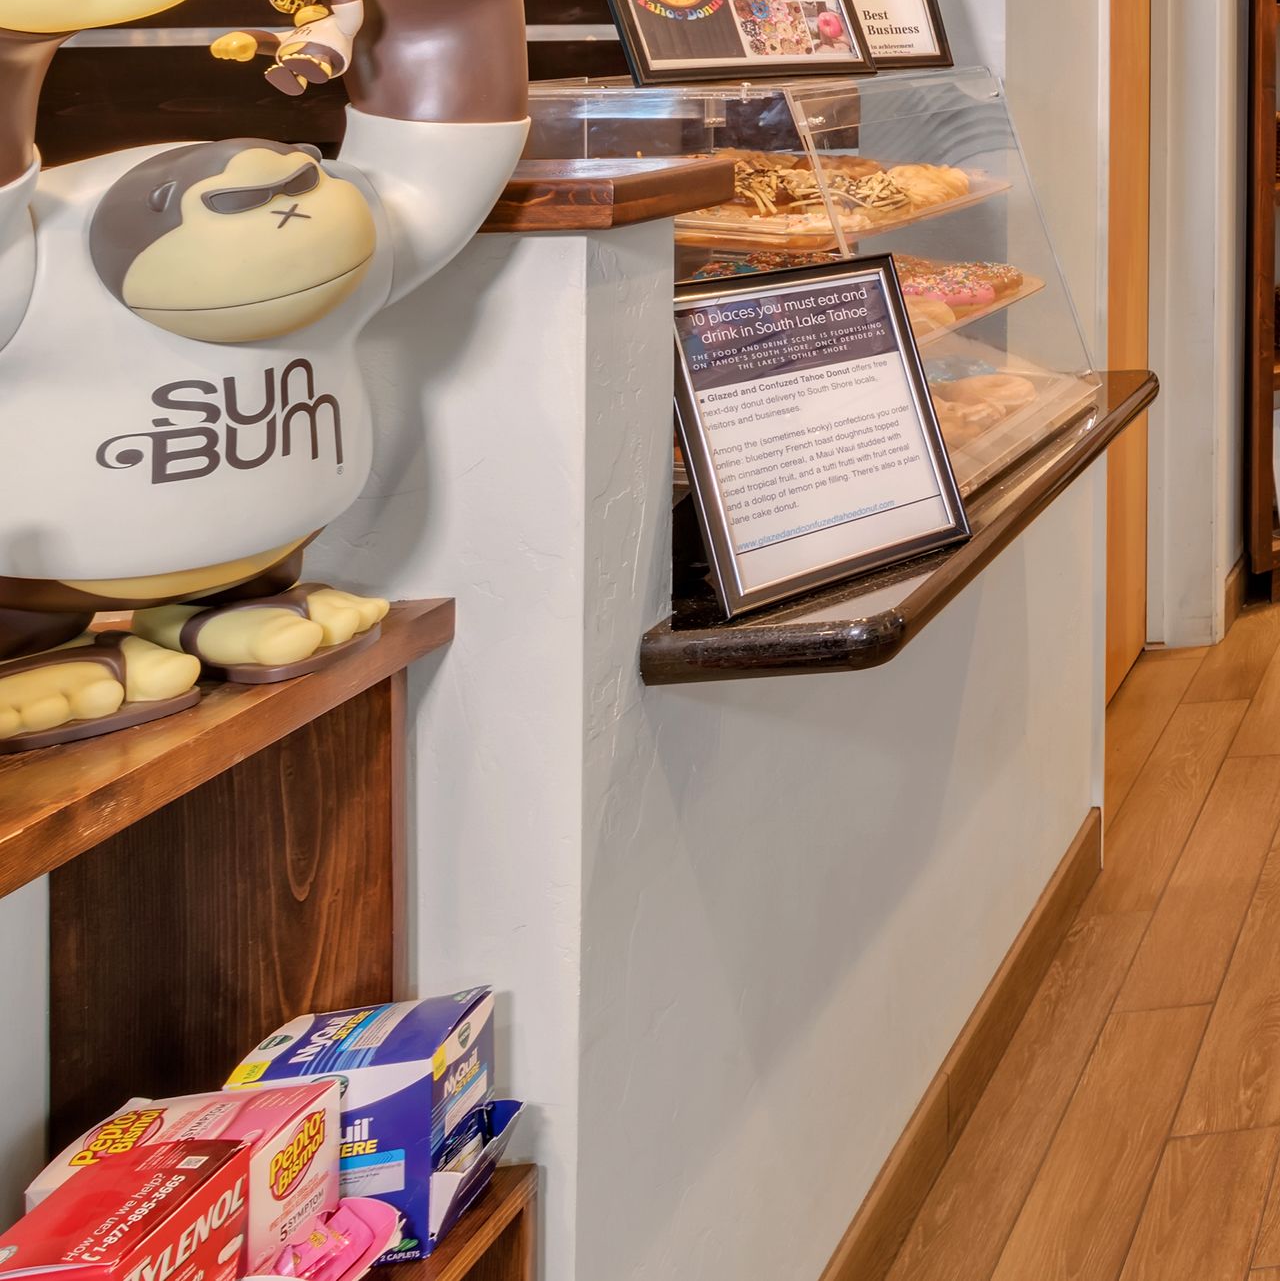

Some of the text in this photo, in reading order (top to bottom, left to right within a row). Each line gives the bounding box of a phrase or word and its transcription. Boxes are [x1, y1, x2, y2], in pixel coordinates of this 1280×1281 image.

[863, 10, 888, 20] Best
[867, 25, 920, 35] Business
[689, 288, 867, 327] 10 places you must eat and
[701, 306, 868, 344] drink in South Lake Tahoe
[692, 353, 708, 362] THE
[712, 348, 738, 358] FOOD
[741, 344, 759, 353] AND
[762, 339, 788, 349] DRINK
[791, 334, 817, 344] SCENE
[830, 322, 882, 336] FLOURISHING
[693, 362, 707, 371] ON
[711, 354, 748, 367] TAHOE'S
[751, 349, 780, 360] SOUTH
[815, 340, 837, 348] ONCE
[840, 332, 873, 343] DERIDED
[738, 363, 754, 371] THE
[757, 357, 785, 367] LAKE'S
[823, 345, 848, 354] SHORE
[703, 404, 739, 418] next-day
[741, 399, 764, 410] donut
[765, 393, 796, 406] delivery
[807, 386, 829, 396] South
[831, 381, 853, 392] Shore
[707, 360, 888, 402] Glazed and Confuzed Tahoe Donut offers free
[706, 419, 736, 431] visitors
[737, 415, 753, 424] and
[713, 404, 909, 457] Among the (sometimes kooky) confections you order
[745, 449, 784, 465] blueberry
[785, 442, 813, 454] French
[815, 438, 833, 446] toast
[835, 428, 874, 442] doughnuts
[875, 420, 899, 433] topped
[719, 474, 736, 484] with
[738, 465, 778, 480] cinnamon
[816, 449, 835, 460] Maui
[857, 438, 886, 450] studded
[887, 433, 901, 442] with
[723, 487, 745, 499] diced
[747, 479, 778, 495] tropical
[799, 469, 814, 479] and
[823, 463, 837, 472] tutti
[857, 454, 872, 463] with
[873, 450, 886, 460] fruit
[887, 443, 910, 455] cereal
[726, 454, 920, 512] and dollop of lemon pie There's also plain
[730, 503, 800, 526] Jane cake donut.
[443, 1047, 479, 1098] NyQuil
[278, 1119, 325, 1197] Bismol
[62, 1173, 169, 1262] How can we help?
[94, 1174, 186, 1256] 1-877-895-3665
[386, 1249, 421, 1261] CAPLETS
